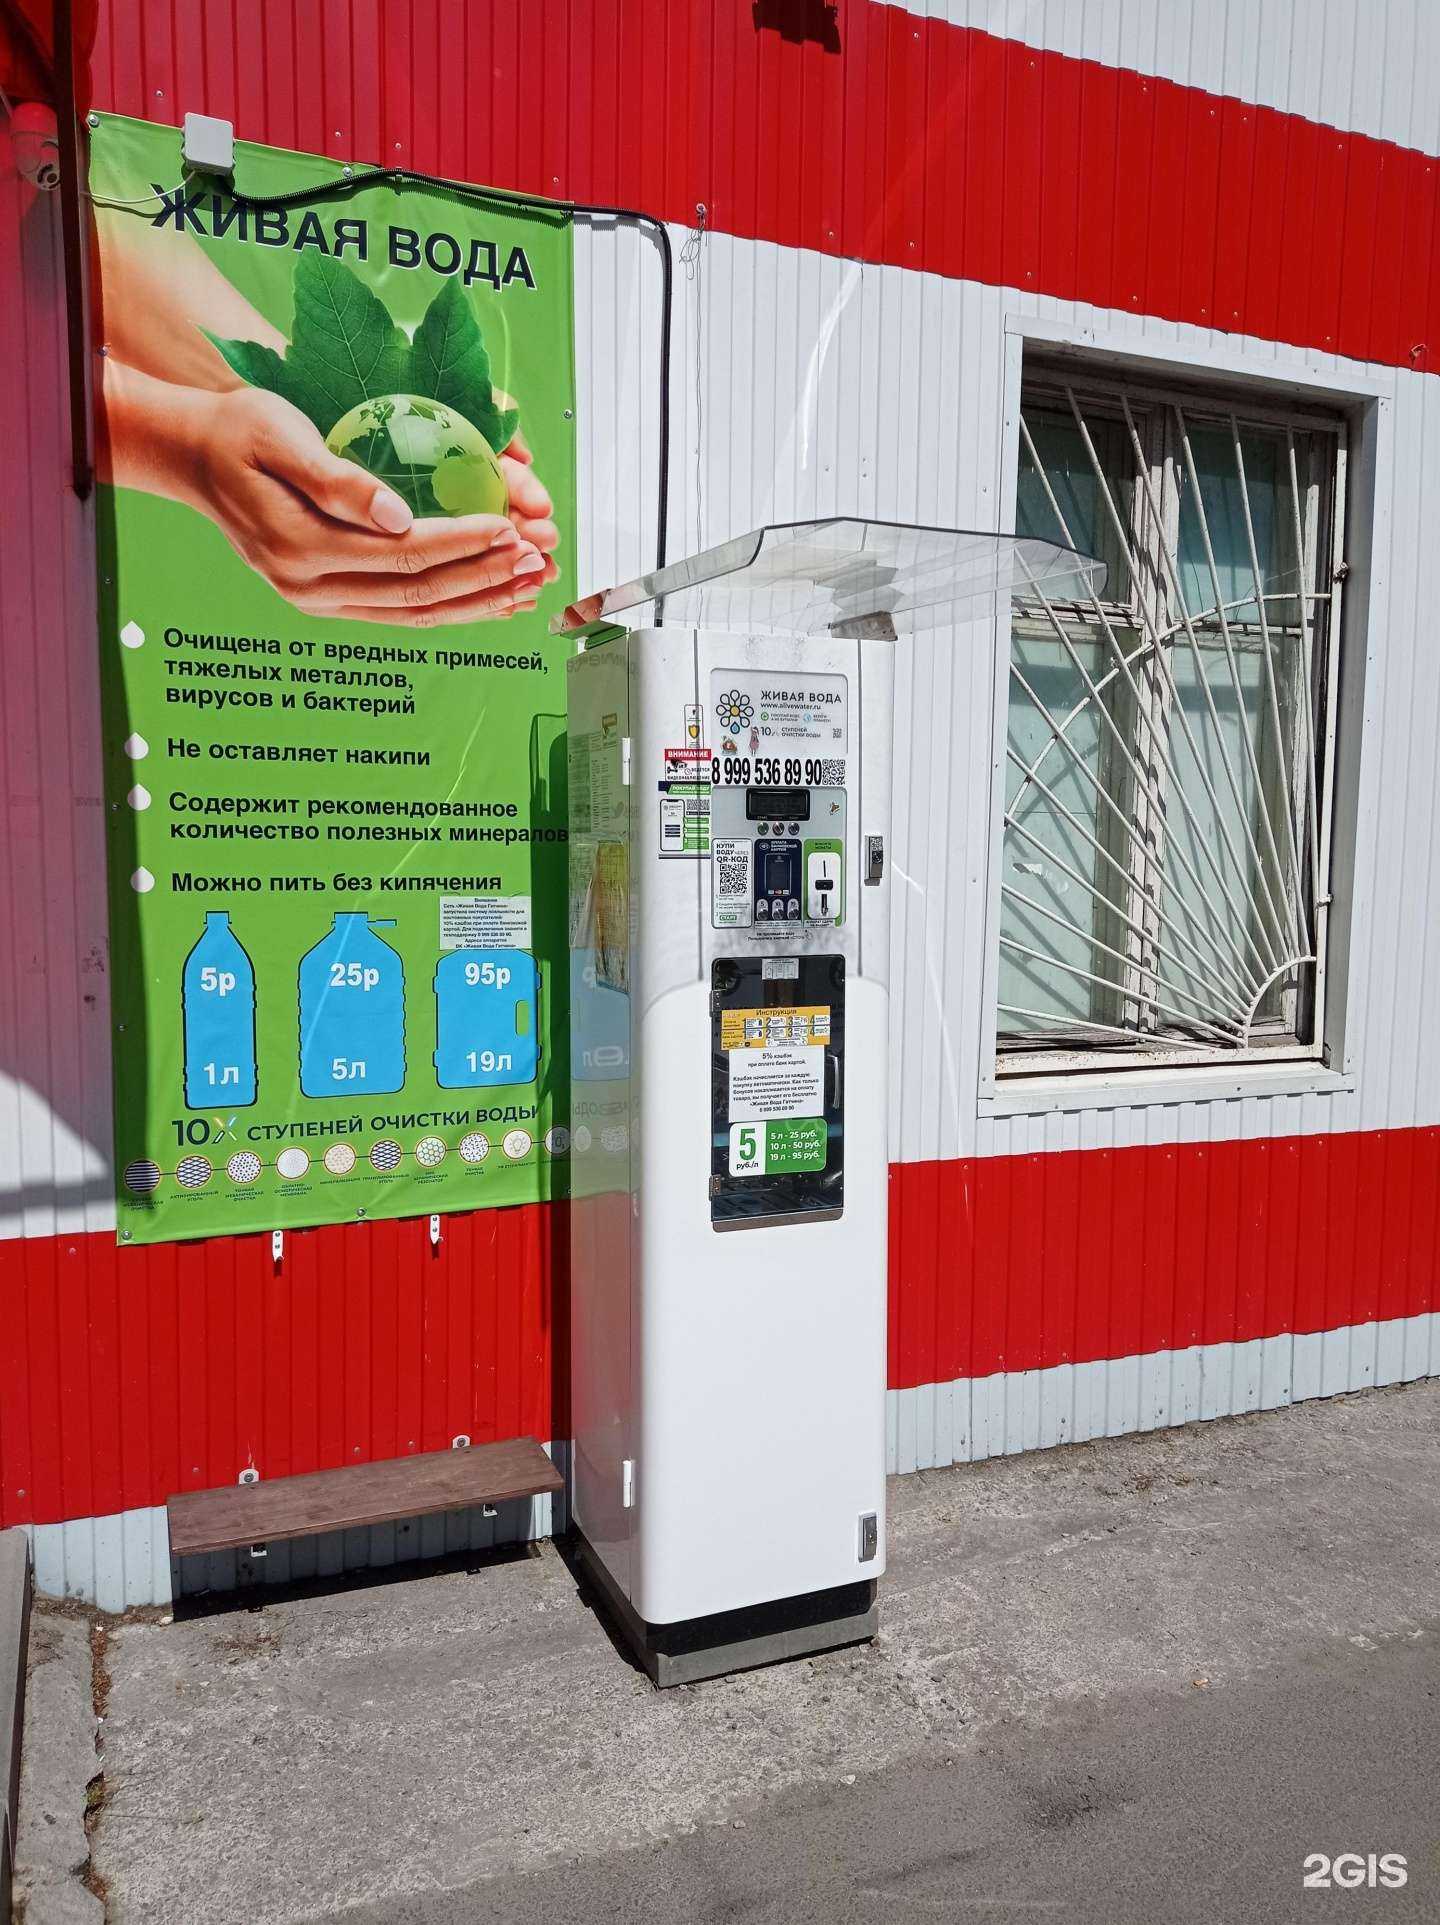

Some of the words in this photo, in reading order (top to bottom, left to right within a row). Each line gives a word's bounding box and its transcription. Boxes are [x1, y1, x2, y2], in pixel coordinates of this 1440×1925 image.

[149, 183, 368, 261] ЖИВАЯ
[387, 225, 537, 291] ВОДА
[163, 627, 281, 656] Очищена
[289, 640, 316, 656] от
[324, 644, 428, 664] вредных
[435, 650, 549, 674] примесей,
[164, 659, 282, 681] тяжелых
[290, 667, 414, 692] металлов,
[166, 689, 273, 710] вирусов
[282, 692, 296, 709] и
[303, 690, 415, 716] бактерий
[761, 690, 805, 702] ЖИВАЯ
[809, 693, 842, 704] ВОДА
[167, 738, 202, 760] Не
[208, 743, 338, 763] оставляет
[346, 747, 431, 766] накипи
[668, 750, 709, 758] ВНИМАНИЕ
[711, 757, 720, 784] 8
[724, 757, 750, 785] 999
[754, 758, 780, 785] 536
[784, 759, 802, 785] 89
[805, 759, 822, 785] 90
[169, 791, 299, 816] Содержит
[308, 799, 518, 820] рекомендованное
[170, 822, 319, 841] количество
[327, 824, 442, 843] полезных
[449, 826, 568, 846] минералов
[172, 872, 261, 895] Можно
[269, 875, 324, 893] пить
[332, 873, 373, 892] без
[380, 874, 502, 892] кипячения
[200, 966, 236, 997] 5р
[330, 963, 380, 992] 25р
[464, 962, 512, 989] 95р
[756, 1009, 797, 1017] Инструкция
[204, 1062, 240, 1085] 1л
[332, 1058, 366, 1081] 5л
[466, 1051, 512, 1073] 19л
[247, 1115, 364, 1142] СТУПЕНЕЙ
[370, 1110, 471, 1132] ОЧИСТКИ
[477, 1105, 542, 1126] ВОДЫ
[770, 1132, 776, 1140] 5
[789, 1131, 799, 1139] 25
[800, 1130, 817, 1140] руб.
[739, 1128, 757, 1161] 5
[770, 1153, 779, 1161] 19
[792, 1152, 802, 1160] 95
[803, 1150, 820, 1160] руб.
[792, 1141, 803, 1149] 50
[804, 1140, 821, 1149] руб.
